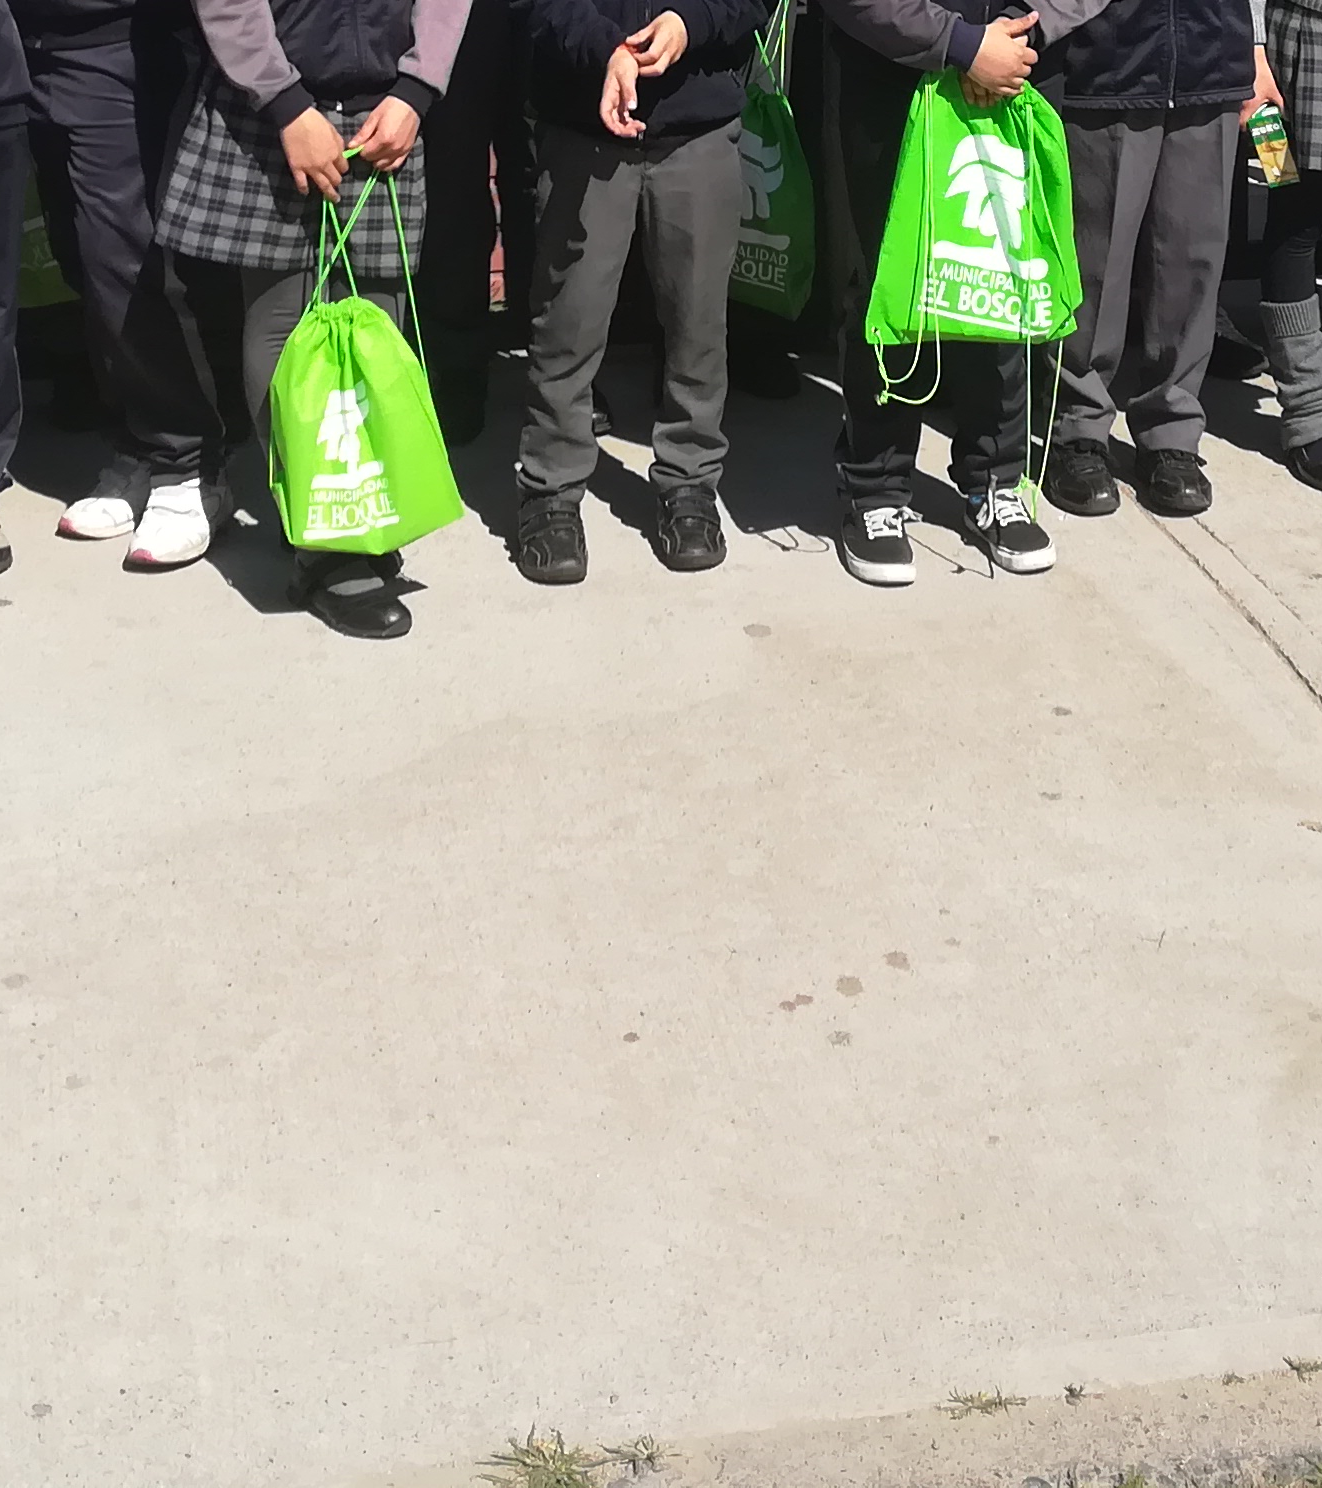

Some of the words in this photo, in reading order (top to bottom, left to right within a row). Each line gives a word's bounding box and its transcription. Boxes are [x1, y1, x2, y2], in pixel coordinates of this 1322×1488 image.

[957, 284, 1053, 328] BOSQUE
[306, 505, 330, 529] EL
[331, 492, 396, 529] BOQUE
